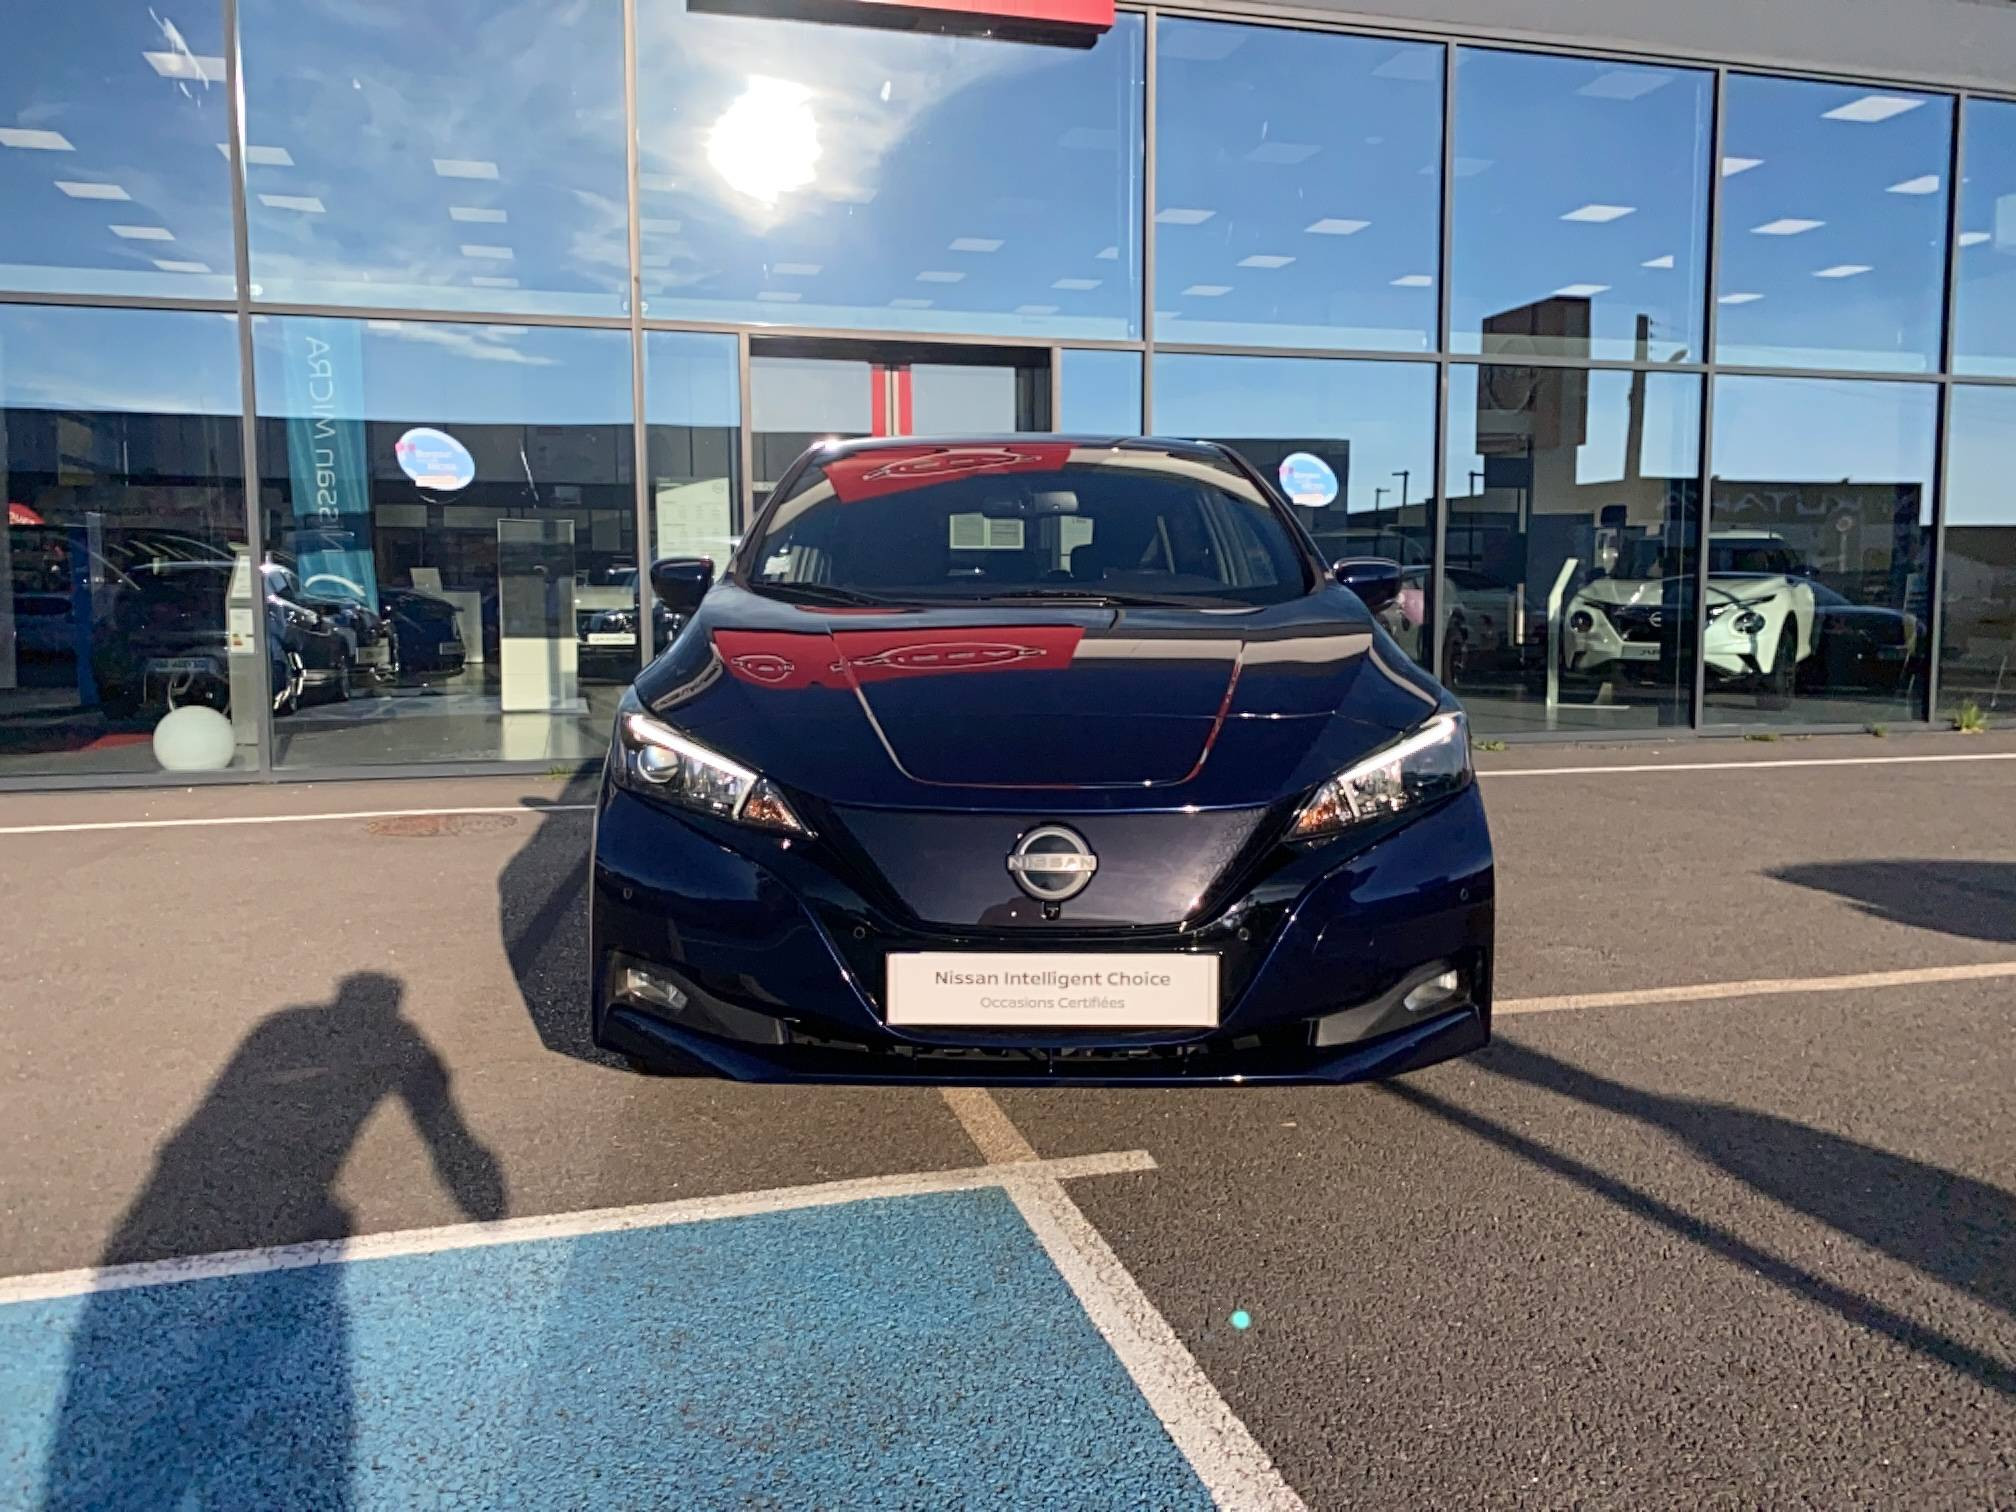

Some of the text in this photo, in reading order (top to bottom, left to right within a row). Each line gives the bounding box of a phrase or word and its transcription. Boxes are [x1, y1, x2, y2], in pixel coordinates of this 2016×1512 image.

[1008, 856, 1095, 869] NISSAN
[935, 970, 1171, 988] Nissan Intelligent Choice
[980, 996, 1125, 1008] Occasions Certifiées
